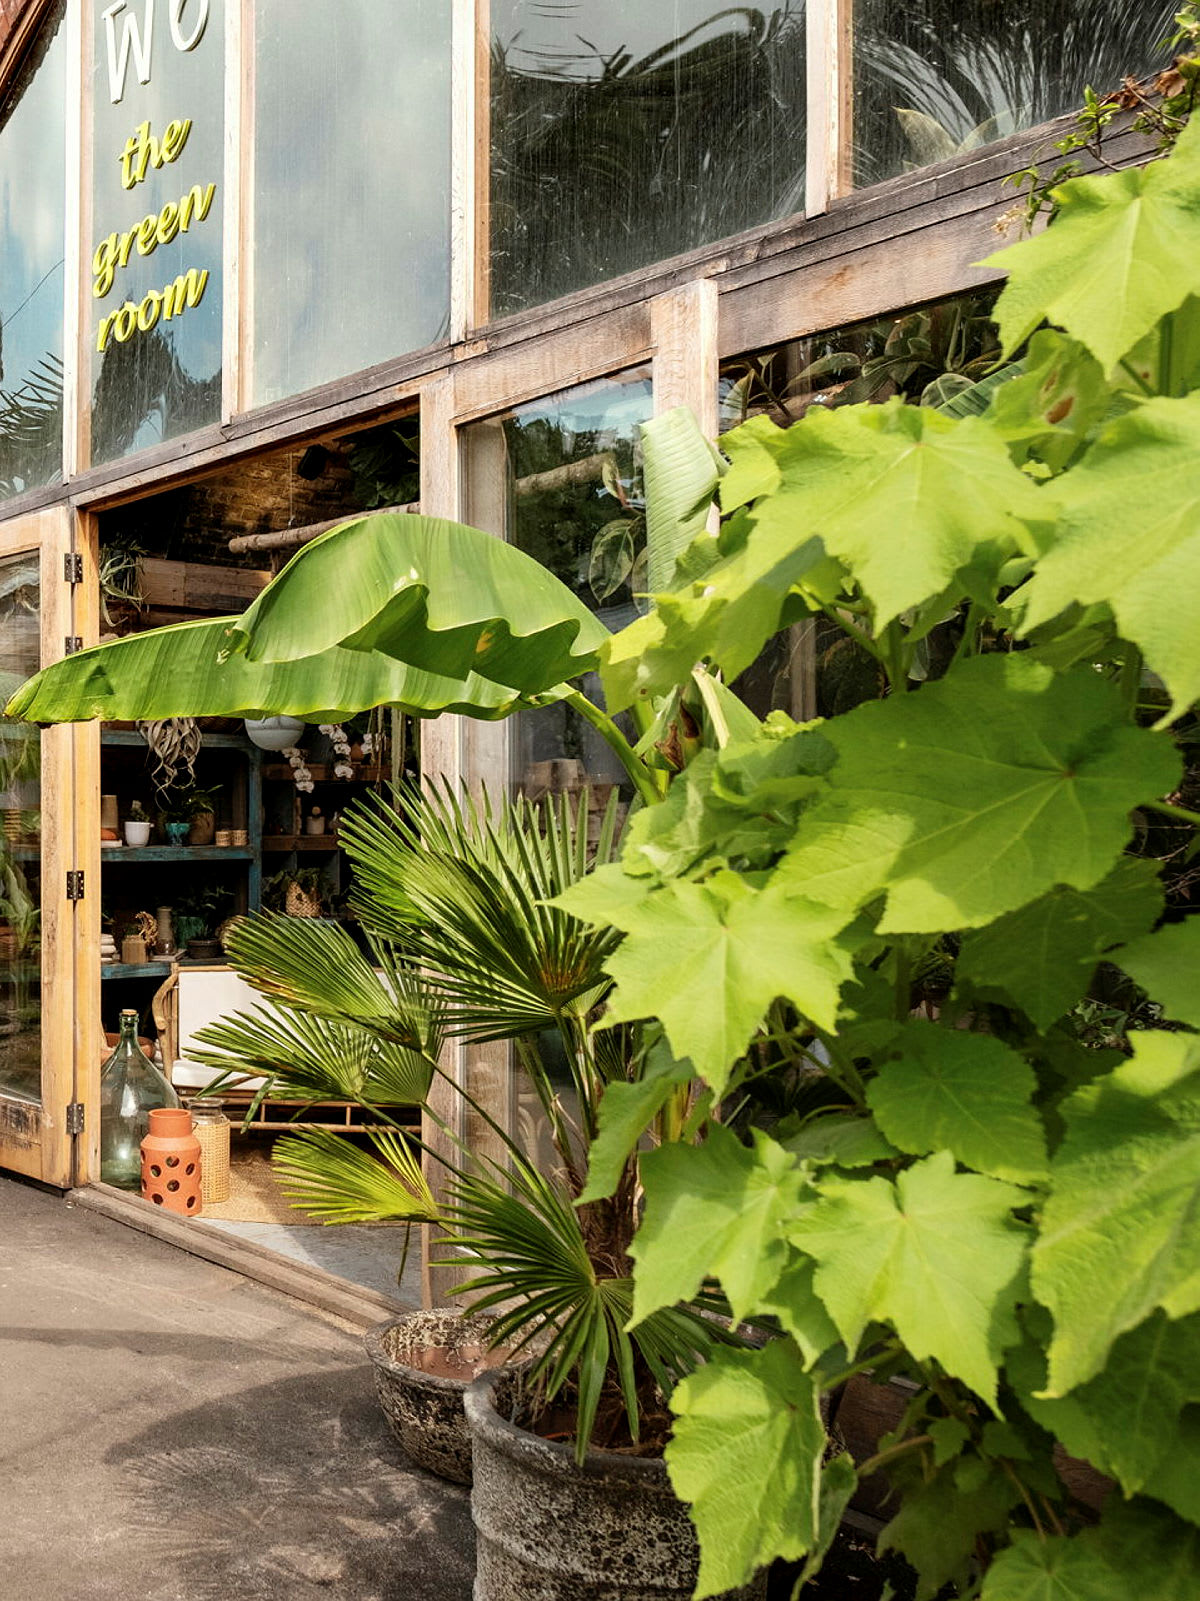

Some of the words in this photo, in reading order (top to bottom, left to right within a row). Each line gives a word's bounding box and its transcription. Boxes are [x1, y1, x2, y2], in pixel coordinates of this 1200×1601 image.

[118, 118, 192, 190] the
[92, 182, 216, 298] green
[96, 267, 209, 352] room
